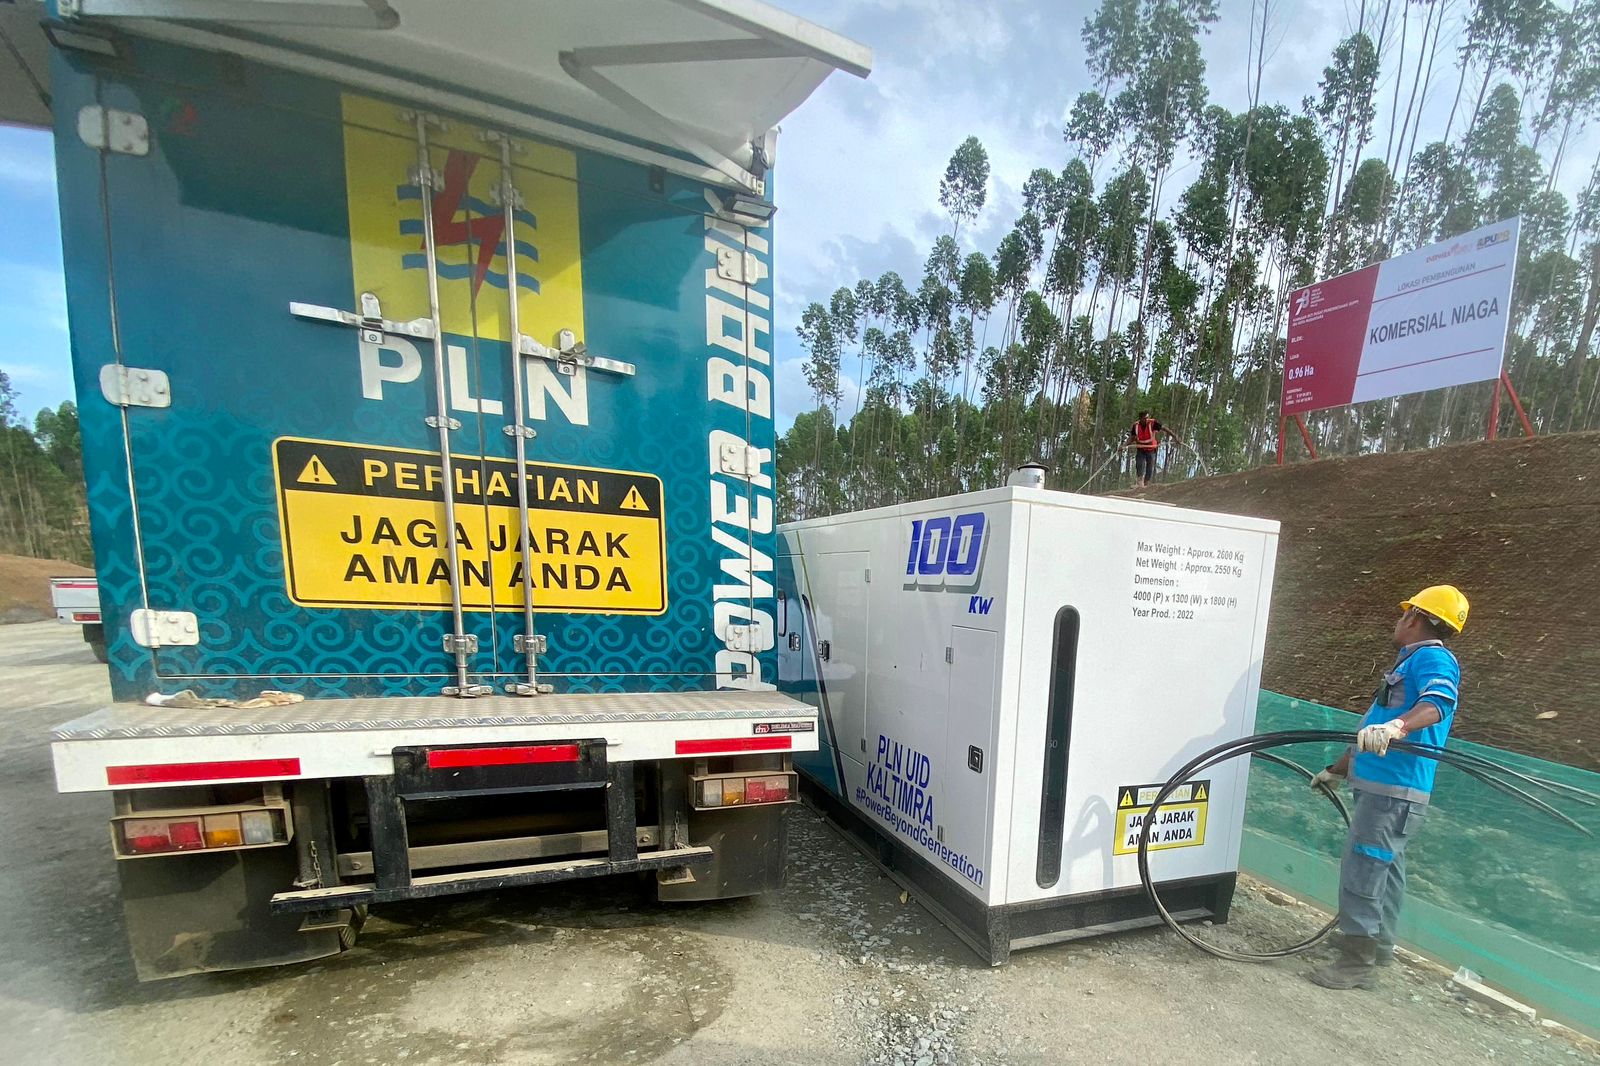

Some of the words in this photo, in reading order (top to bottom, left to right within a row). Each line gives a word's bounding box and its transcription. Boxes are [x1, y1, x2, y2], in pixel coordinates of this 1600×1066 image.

[1397, 280, 1421, 292] LOKASI
[1422, 262, 1476, 284] PEMBANGUNAN
[703, 187, 771, 420] BANK
[1369, 310, 1447, 345] KOMERSIAL
[1451, 297, 1499, 326] NIAGA
[359, 334, 589, 426] PLN
[1288, 367, 1304, 380] 0.96
[1304, 364, 1315, 377] Ha
[340, 514, 473, 551] JAGA
[490, 524, 630, 559] JARAK
[904, 511, 988, 590] 100
[709, 429, 778, 692] POWER
[1135, 557, 1149, 568] Net
[1151, 558, 1177, 572] Weight
[1185, 561, 1213, 575] Approx.
[1215, 564, 1231, 575] 2550
[1232, 566, 1242, 578] Kg
[1137, 541, 1153, 553] Max
[1155, 543, 1181, 557] Weight
[1187, 546, 1215, 560] Approx.
[1234, 551, 1245, 564] Kg
[344, 554, 490, 587] AMAN
[508, 562, 632, 593] ANDA
[1134, 574, 1175, 587] Dimension
[968, 595, 994, 615] KW
[1132, 607, 1150, 617] Year
[1151, 608, 1171, 619] Prod.
[1177, 609, 1194, 620] 2022
[1133, 591, 1152, 601] 4000
[1152, 592, 1163, 604] (P)
[1172, 593, 1189, 604] 1300
[1189, 594, 1202, 607] (W)
[1210, 595, 1226, 606] 1800
[1227, 596, 1237, 609] (H)
[877, 734, 903, 775] PLN
[906, 747, 932, 789] UID
[867, 761, 934, 831] KALTIMRA
[1140, 788, 1191, 802] PERIAN
[1129, 813, 1157, 828] JAA
[1160, 810, 1195, 825] JARAK
[856, 786, 984, 886] #PowerBeyondGeneration
[1163, 828, 1193, 842] ANDA
